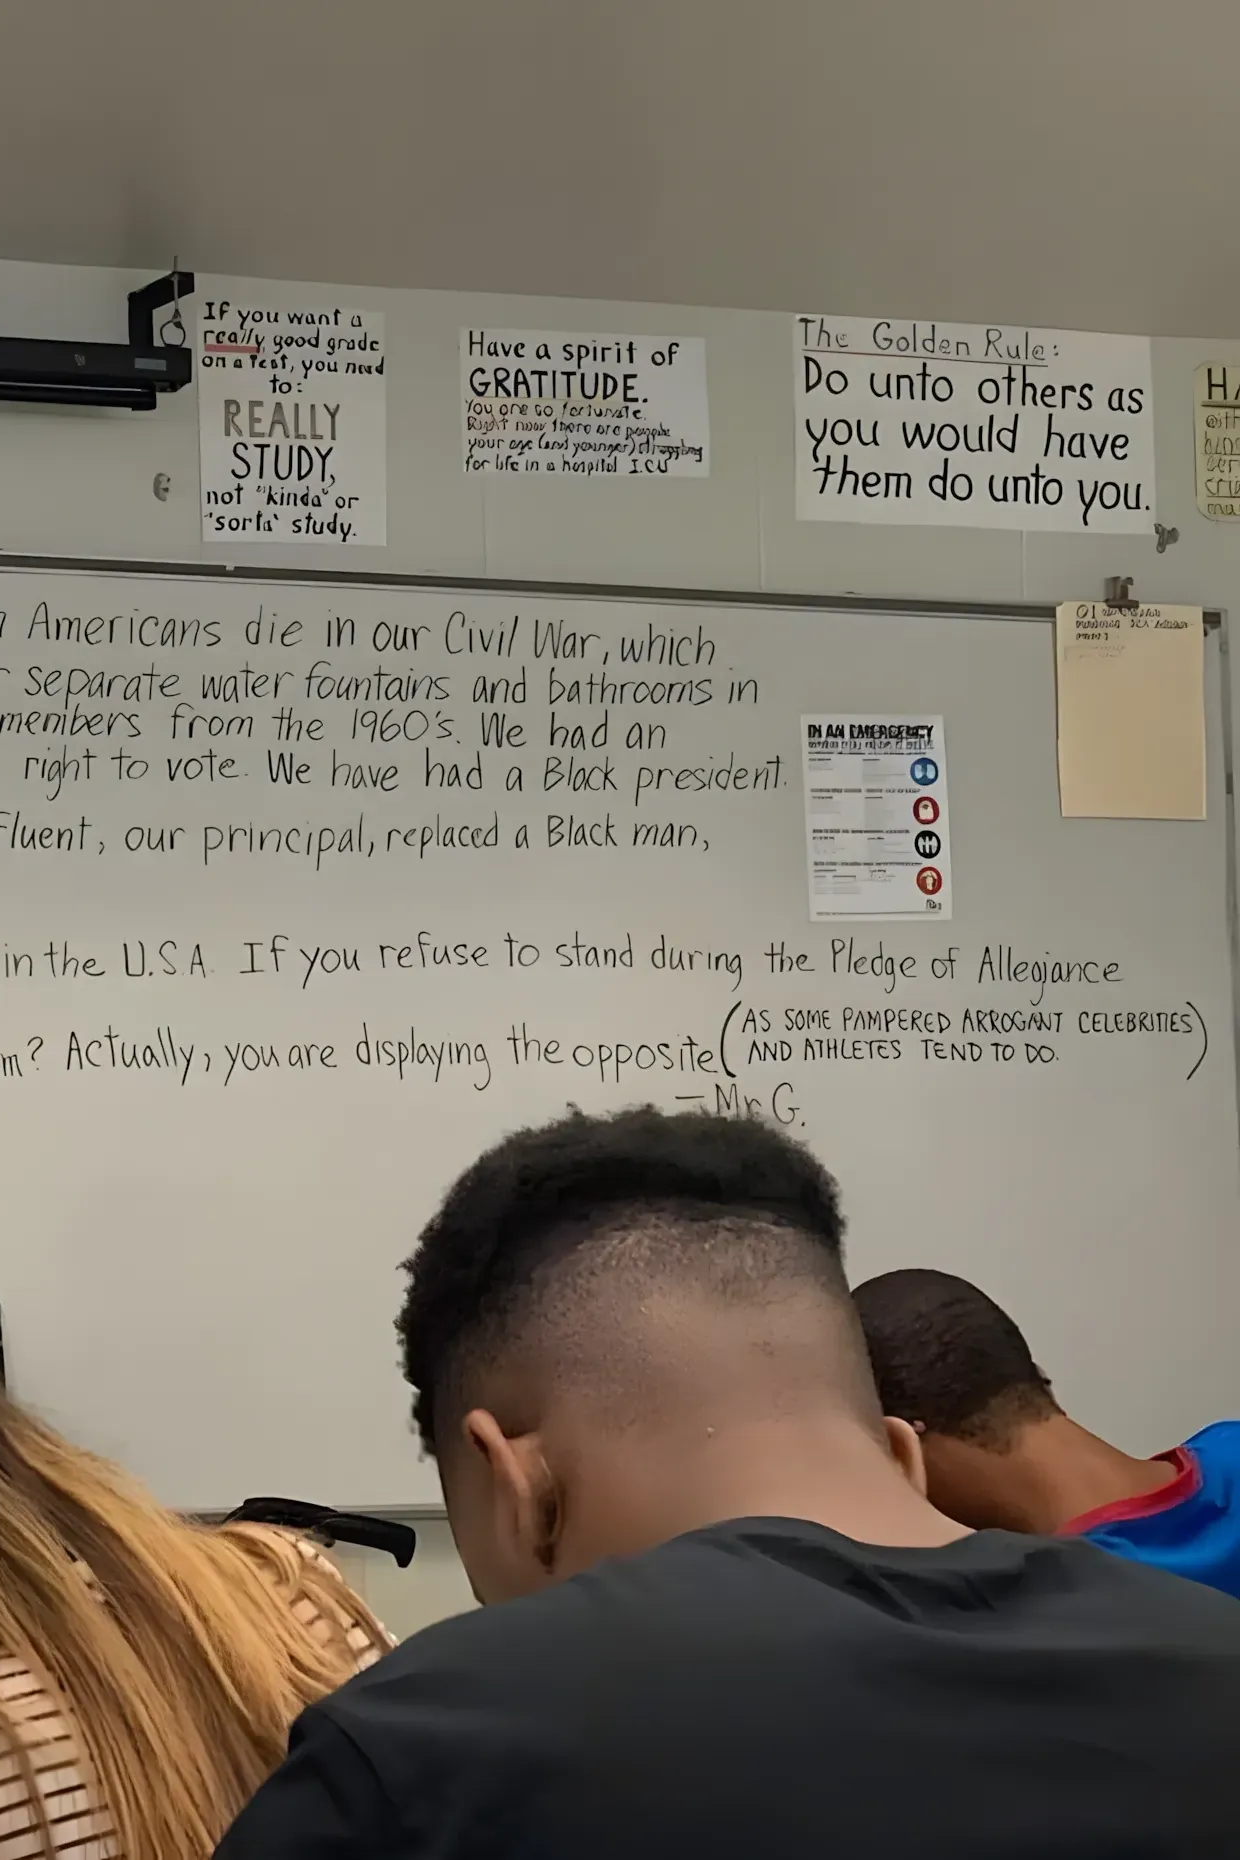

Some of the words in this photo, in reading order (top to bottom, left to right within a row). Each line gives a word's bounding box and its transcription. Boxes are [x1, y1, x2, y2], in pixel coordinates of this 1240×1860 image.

[203, 302, 231, 321] If
[237, 309, 280, 329] you
[287, 309, 341, 328] want
[352, 314, 362, 328] a
[273, 327, 320, 353] good
[327, 332, 380, 356] grade
[468, 331, 525, 360] Have
[536, 341, 551, 360] a
[562, 339, 638, 369] spirit
[650, 341, 681, 367] of
[798, 317, 850, 350] The
[872, 322, 971, 357] Golden
[985, 328, 1060, 362] Rule:
[202, 353, 227, 370] on
[232, 357, 244, 369] a
[301, 359, 339, 378] you
[275, 374, 304, 394] to:
[803, 355, 848, 395] Do
[869, 362, 955, 403] unto
[977, 365, 1093, 412] others
[1108, 385, 1144, 414] as
[469, 369, 649, 404] GRATITUDE.
[223, 400, 340, 440] REALLY
[805, 417, 879, 462] you
[902, 414, 1019, 454] would
[1044, 413, 1130, 460] have
[231, 443, 336, 487] STUDY,
[205, 483, 243, 505] not
[334, 494, 360, 510] or
[811, 455, 912, 499] them
[928, 459, 973, 501] do
[989, 464, 1063, 505] unto
[1078, 478, 1151, 526] you.
[291, 512, 358, 542] study.
[27, 601, 221, 647] Americans
[246, 605, 303, 646] die
[373, 622, 431, 654] our
[445, 611, 517, 657] Civil
[534, 619, 609, 665] War,
[621, 624, 715, 667] which
[24, 662, 181, 709] separate
[201, 662, 294, 701] water
[306, 661, 450, 701] fountains
[472, 667, 527, 704] and
[549, 667, 713, 705] bathrooms
[171, 703, 253, 740] from
[24, 742, 96, 800] right
[166, 748, 248, 781] vote.
[331, 749, 399, 790] have
[544, 757, 617, 792] Black
[636, 752, 787, 807] president.
[125, 825, 186, 851] our
[204, 813, 374, 871] principal,
[386, 811, 499, 859] replaced
[547, 814, 617, 848] Black
[632, 823, 709, 852] man,
[379, 931, 489, 971] refuse
[556, 931, 634, 968] stand
[650, 935, 743, 992] during
[831, 937, 917, 994] Pledge
[784, 1007, 832, 1032] SOME
[842, 1007, 951, 1033] PAMPERED
[962, 1010, 1063, 1034] ARROGANT
[67, 1025, 211, 1086] Actually,
[224, 1044, 280, 1086] you
[357, 1022, 492, 1092] displaying
[506, 1022, 564, 1065] the
[572, 1036, 718, 1083] opposite
[748, 1041, 793, 1064] AND
[804, 1039, 902, 1062] ATHLETES
[922, 1039, 984, 1062] TEND
[993, 1042, 1016, 1062] TO
[1024, 1044, 1059, 1065] DO.
